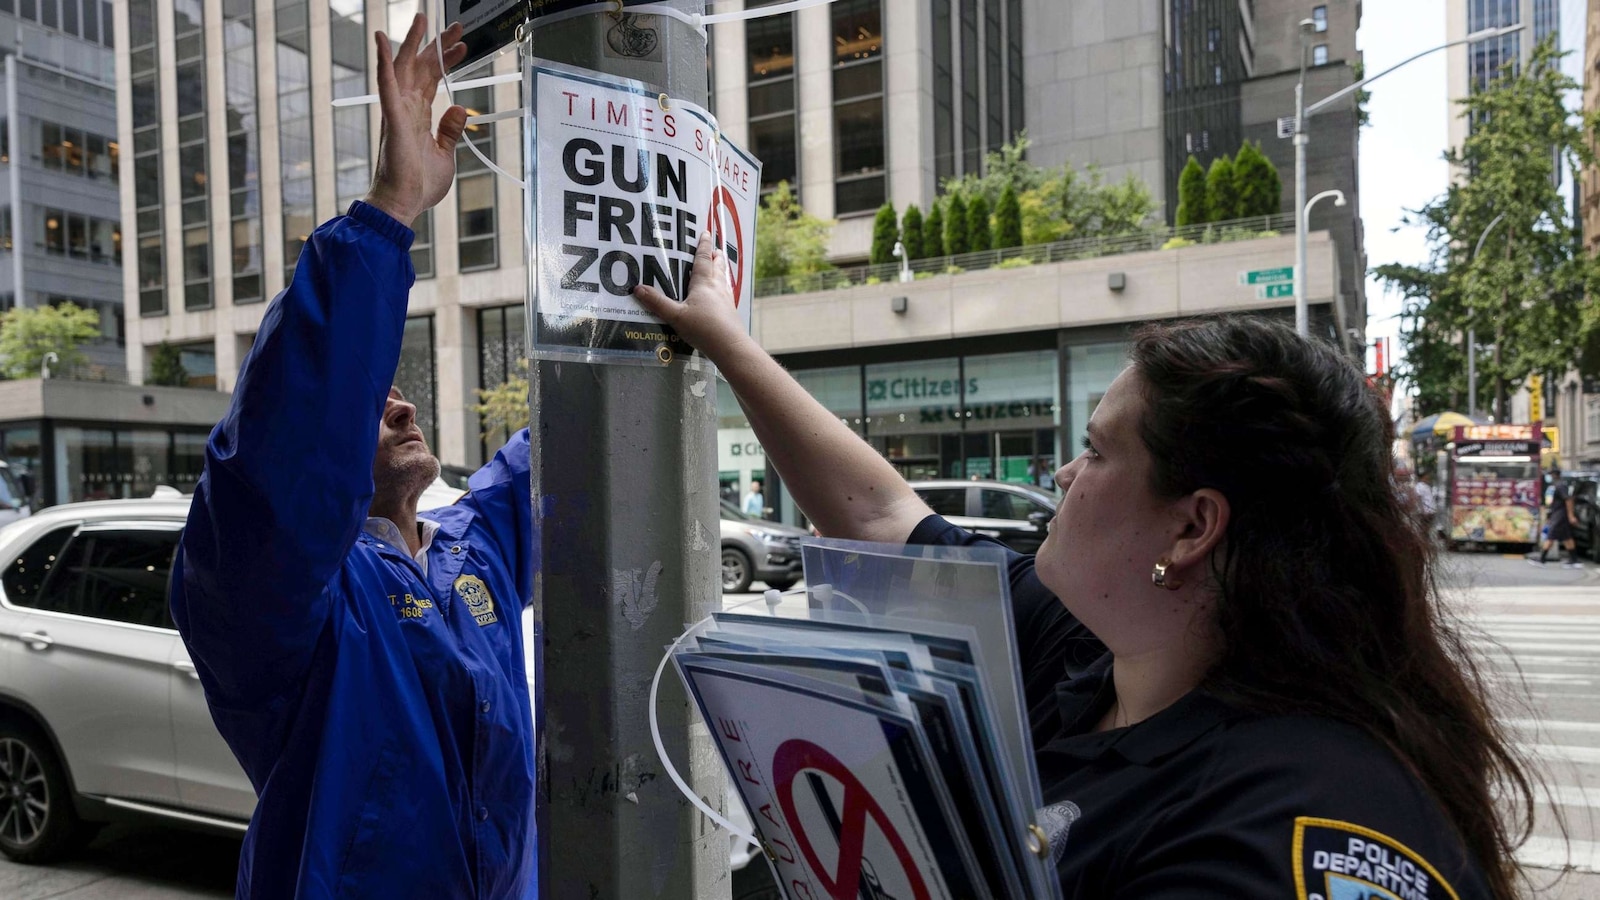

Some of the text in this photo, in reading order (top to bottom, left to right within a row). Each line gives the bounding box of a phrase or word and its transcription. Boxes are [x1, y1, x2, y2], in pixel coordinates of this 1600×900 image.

[562, 91, 676, 137] TIMES
[562, 138, 688, 204] GUN
[563, 190, 697, 255] FREE
[603, 306, 626, 315] carriers
[628, 307, 640, 316] and
[625, 331, 669, 342] VIOLATION
[948, 397, 1054, 420] Ctizens
[718, 716, 813, 900] QUARE
[1347, 837, 1430, 894] POLICE
